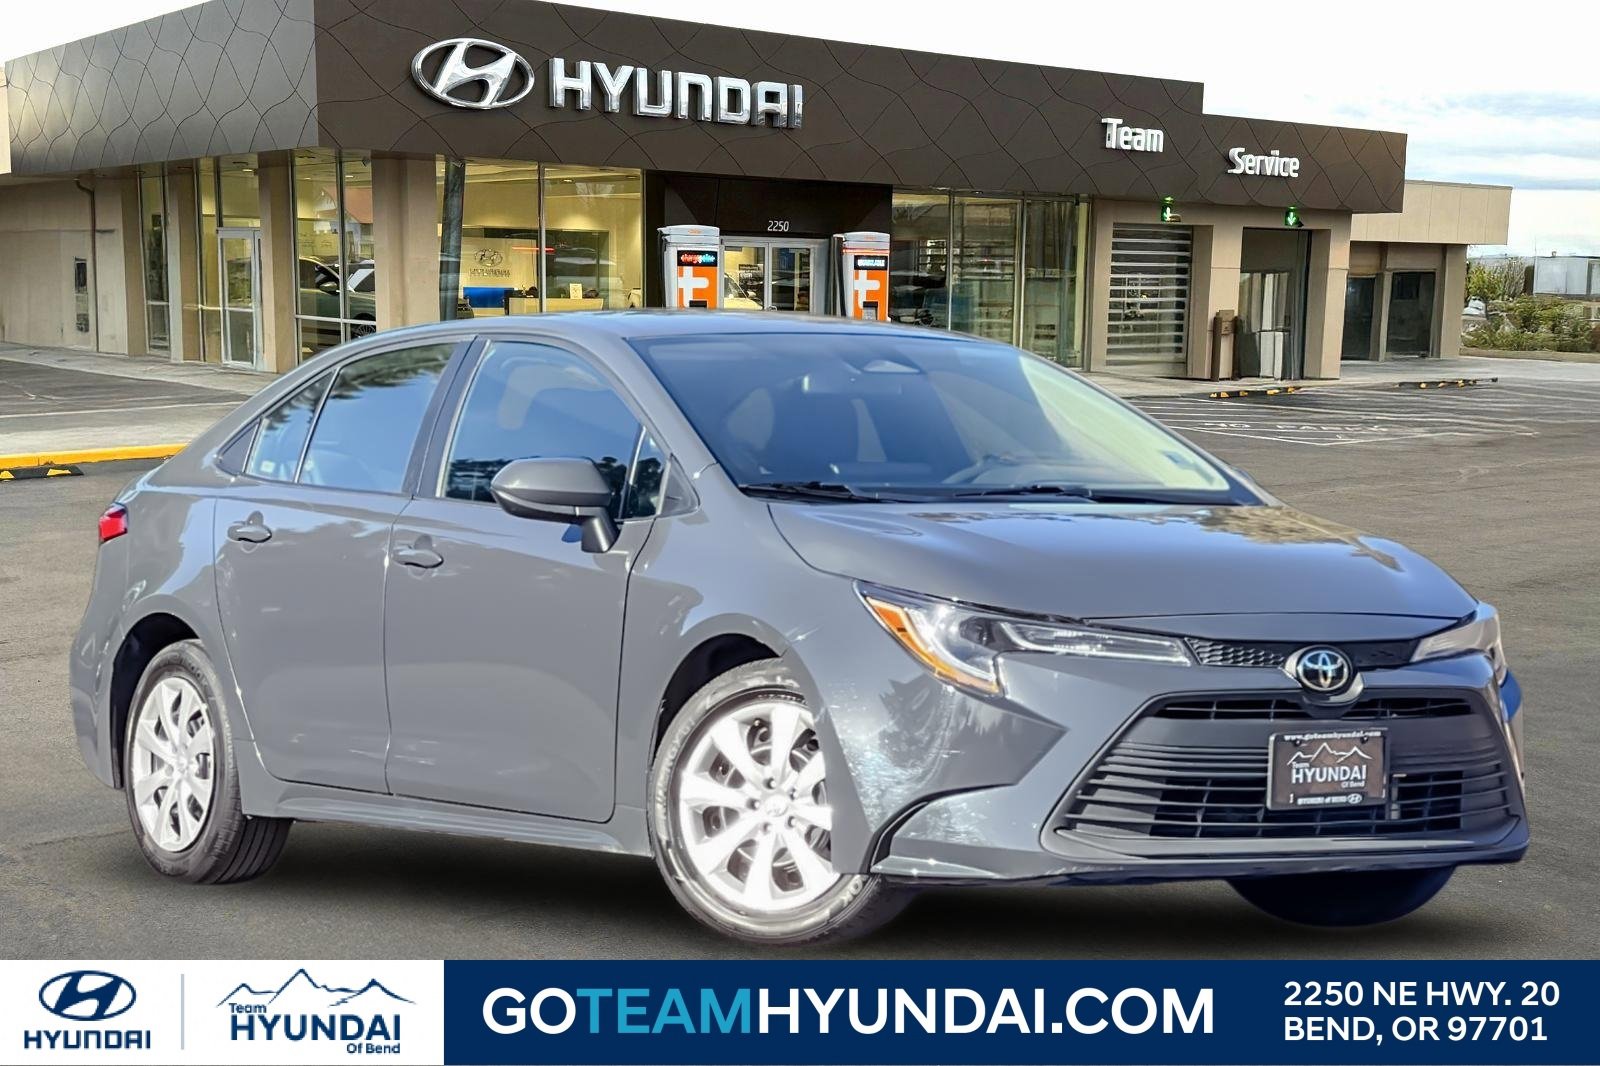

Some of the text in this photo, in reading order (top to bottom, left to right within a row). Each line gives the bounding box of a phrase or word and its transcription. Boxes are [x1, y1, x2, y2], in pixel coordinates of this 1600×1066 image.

[549, 57, 804, 129] HYUNDAI
[1101, 117, 1164, 153] Team
[1227, 147, 1300, 178] Service
[767, 220, 790, 232] 2250
[1291, 764, 1367, 784] HYUNDAI
